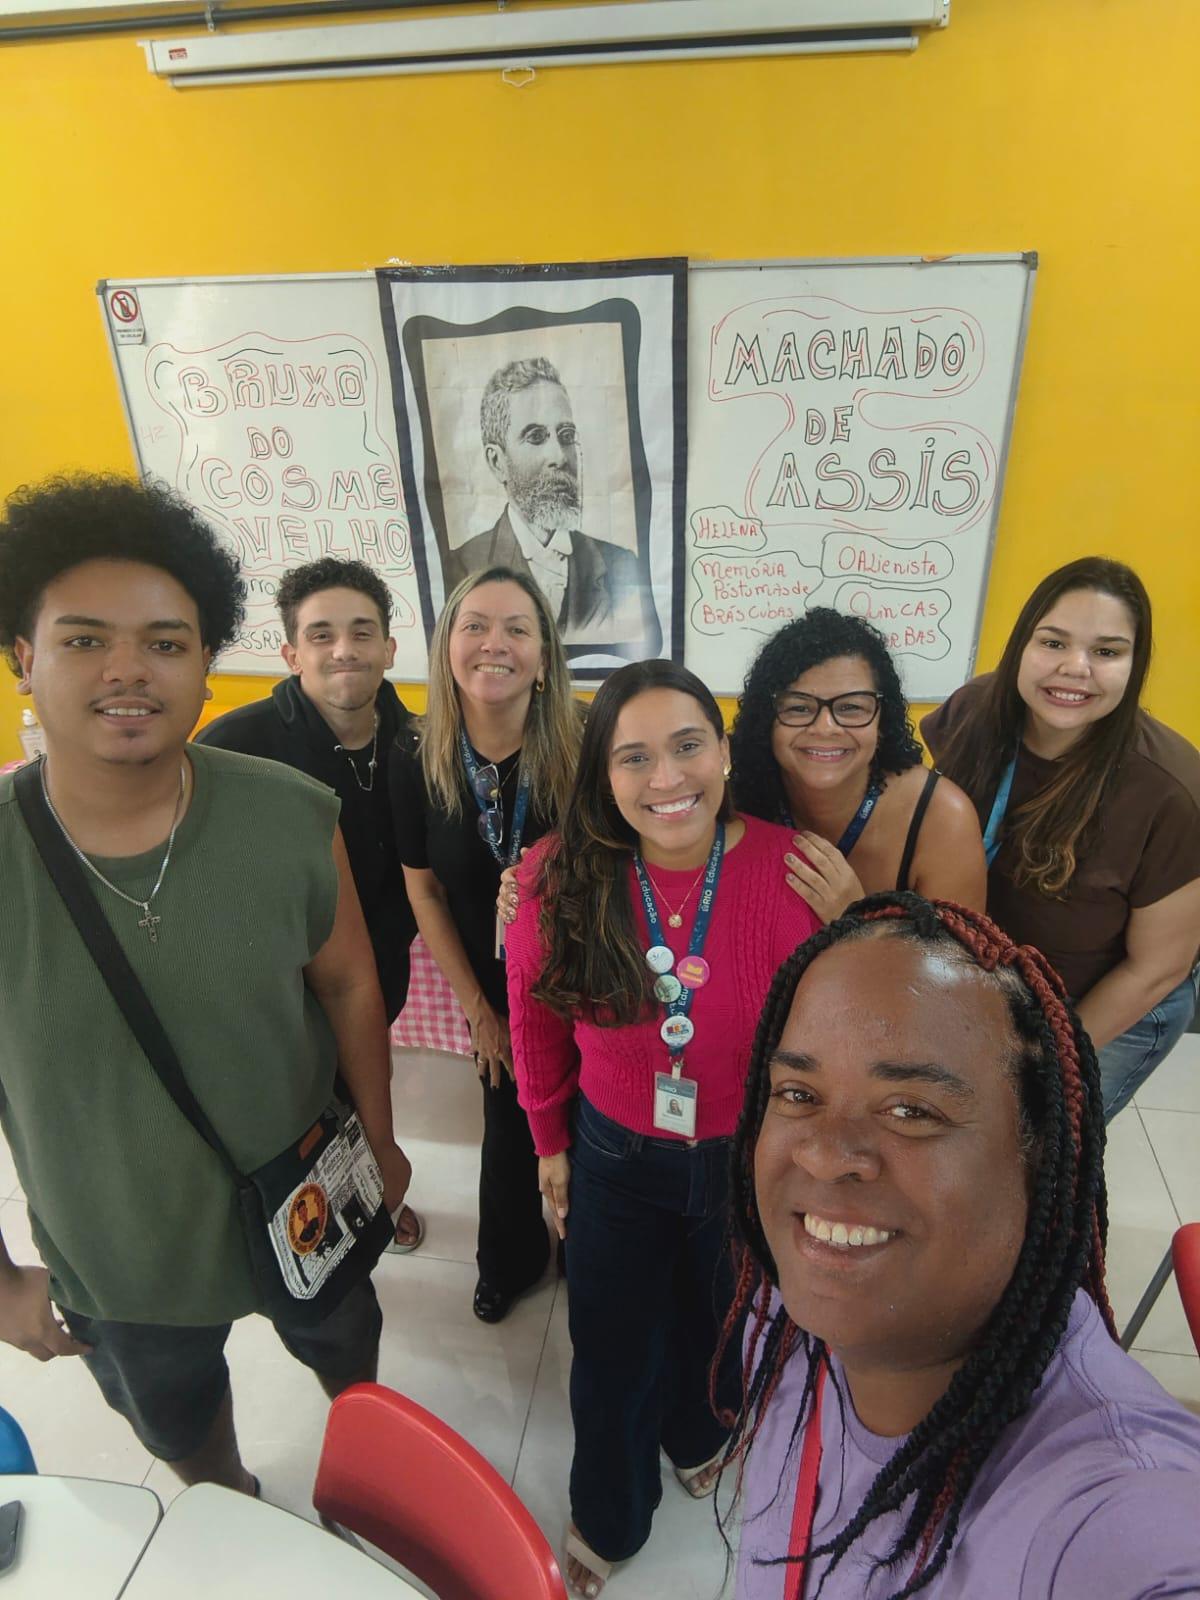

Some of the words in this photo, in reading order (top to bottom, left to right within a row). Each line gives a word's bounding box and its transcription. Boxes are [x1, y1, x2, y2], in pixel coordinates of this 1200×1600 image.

[725, 326, 966, 386] MACHADO
[178, 359, 367, 417] BRUXO
[246, 426, 293, 460] DO
[804, 405, 854, 445] DE
[200, 457, 400, 514] COSME
[232, 515, 412, 567] VELHO
[699, 515, 758, 540] HELENA
[705, 840, 721, 884] Educação
[640, 879, 659, 924] Educação
